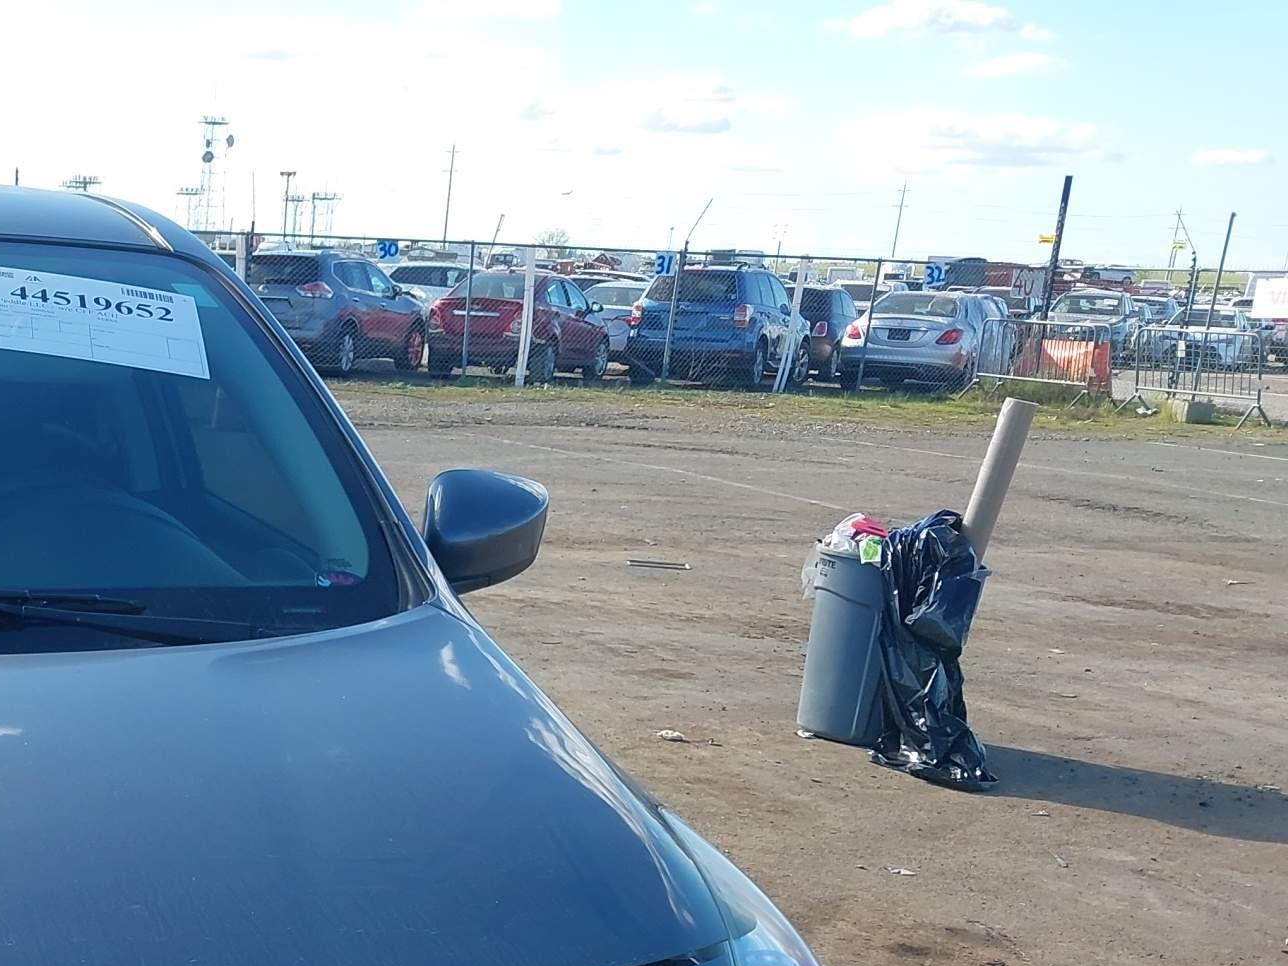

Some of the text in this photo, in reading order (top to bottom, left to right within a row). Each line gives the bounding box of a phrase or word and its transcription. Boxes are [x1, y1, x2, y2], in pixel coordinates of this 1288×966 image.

[377, 241, 399, 259] 30
[655, 255, 674, 274] 31
[925, 265, 946, 285] 32
[10, 286, 174, 322] 44519652
